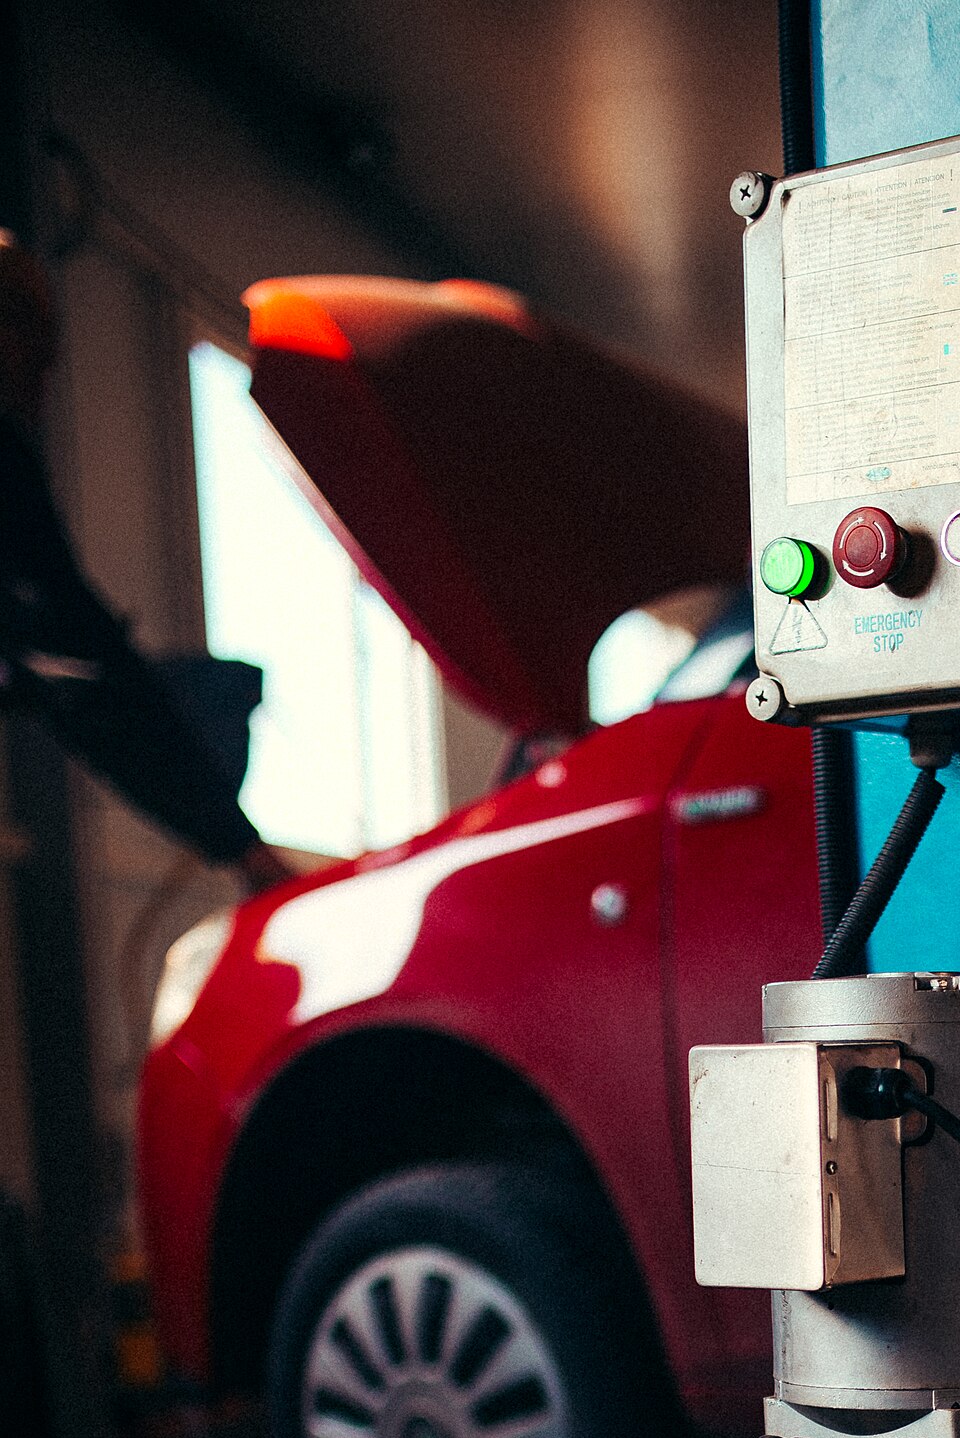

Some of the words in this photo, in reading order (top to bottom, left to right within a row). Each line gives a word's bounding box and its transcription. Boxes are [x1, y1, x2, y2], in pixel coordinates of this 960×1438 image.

[841, 190, 868, 201] CAUTION
[875, 182, 908, 194] ATTENTION
[854, 610, 923, 635] EMERGENCY
[873, 633, 904, 653] STOP
